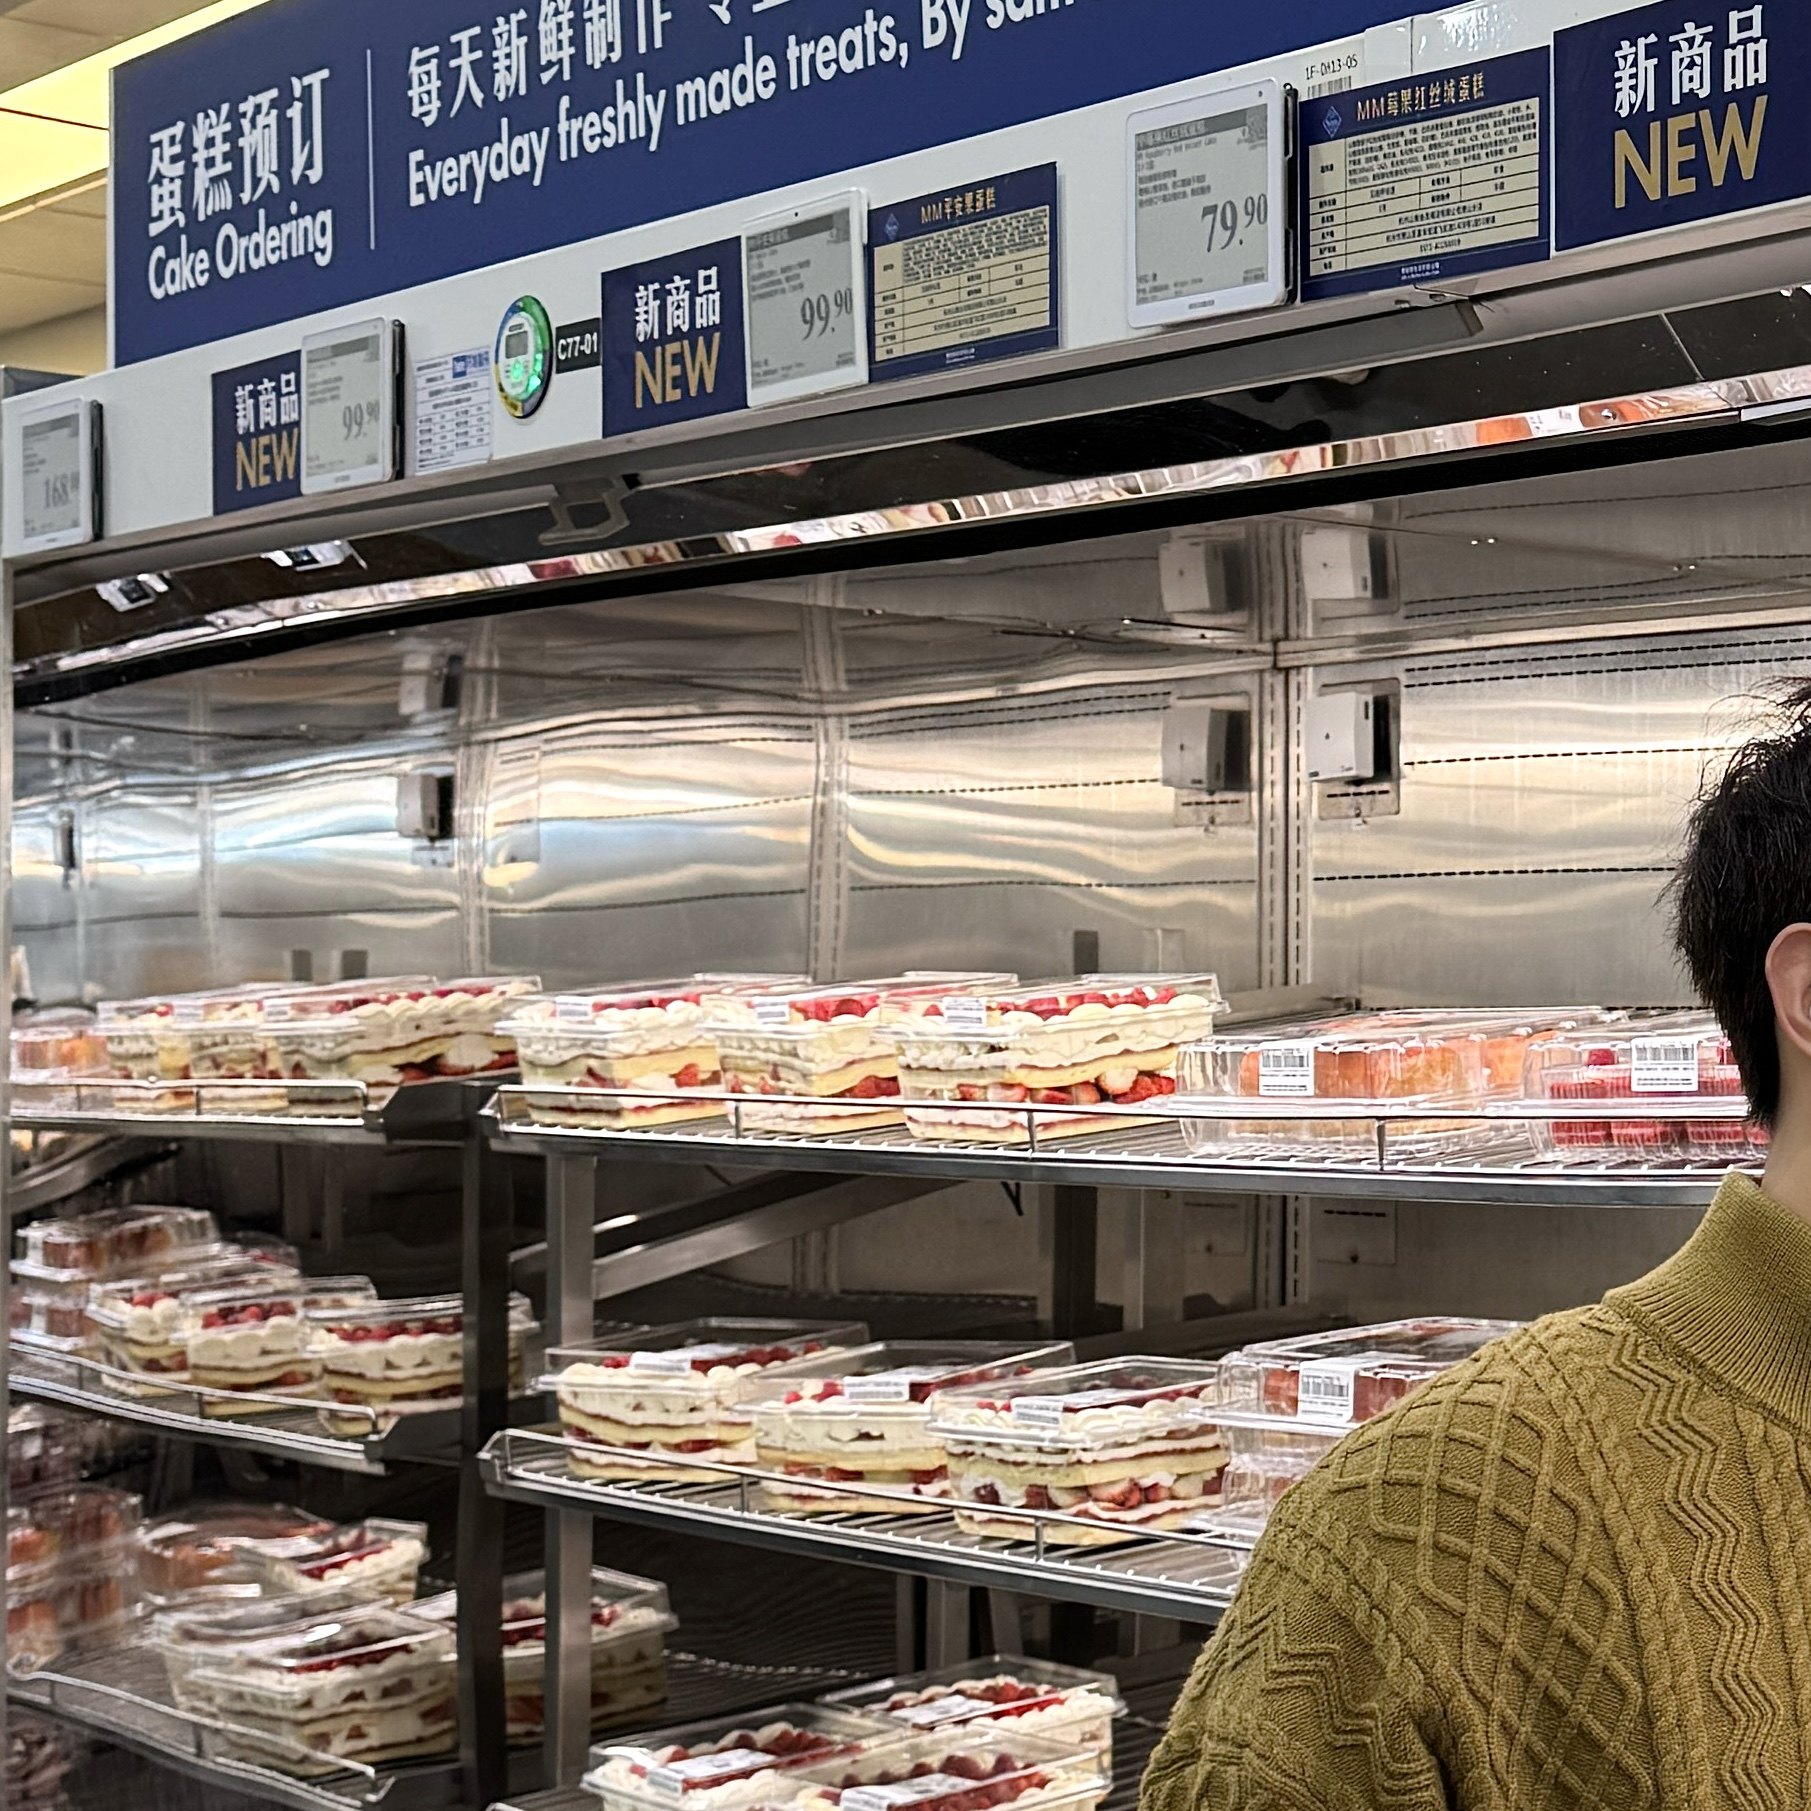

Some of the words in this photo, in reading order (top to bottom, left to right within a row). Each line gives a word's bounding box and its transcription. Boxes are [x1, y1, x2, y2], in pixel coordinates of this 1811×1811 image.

[1613, 4, 1768, 118] 新商品
[408, 117, 550, 207] Everyday
[557, 72, 666, 152] freshly
[675, 35, 777, 125] made
[786, 8, 909, 68] treats,
[921, 0, 971, 61] By
[148, 68, 330, 237] 蛋糕预订
[1613, 94, 1769, 209] NEW
[148, 234, 210, 300] Cake
[215, 200, 333, 279] Ordering
[1201, 193, 1268, 253] 79.90
[634, 266, 721, 342] 新商品
[801, 287, 853, 341] 99.90
[558, 331, 598, 360] C77-01
[634, 332, 721, 408] NEW
[235, 371, 299, 434] 新商品
[235, 427, 299, 491] NEW
